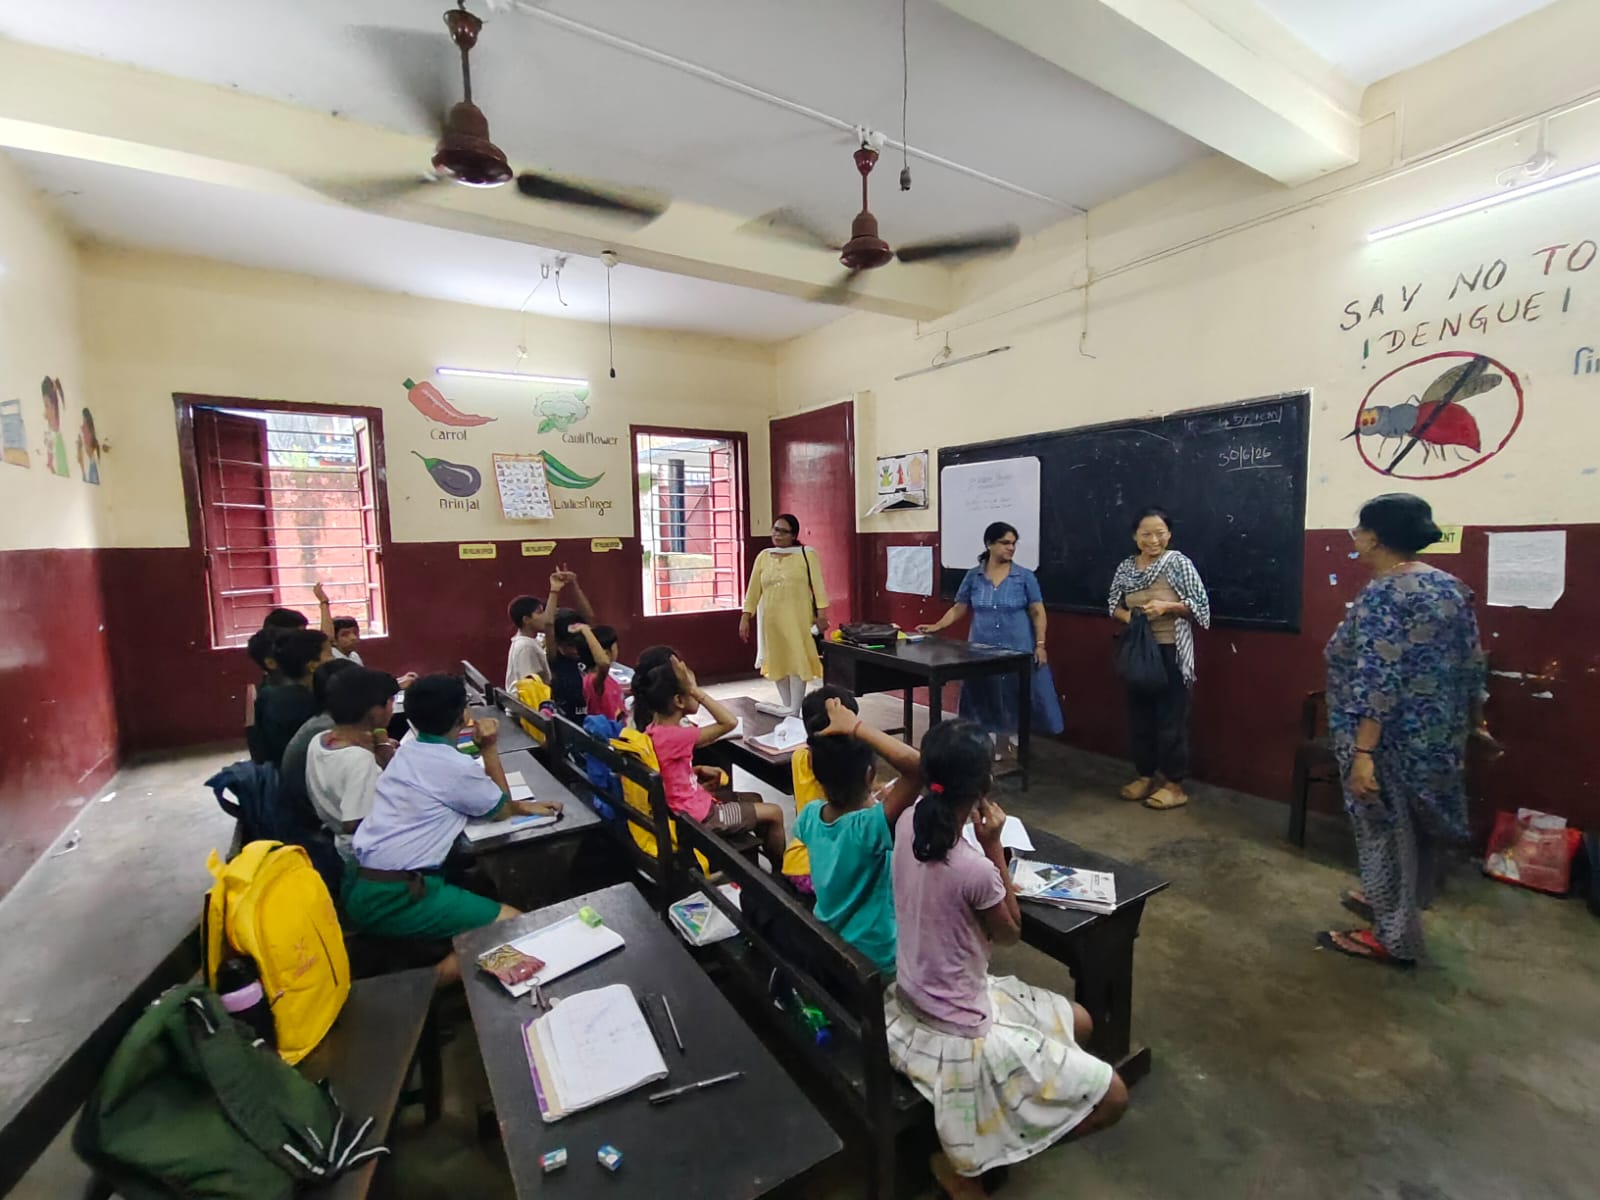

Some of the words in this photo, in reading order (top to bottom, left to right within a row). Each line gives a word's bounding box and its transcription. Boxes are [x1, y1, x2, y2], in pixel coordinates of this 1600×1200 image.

[1340, 283, 1423, 331] SAY
[1449, 259, 1508, 300] NO
[1532, 240, 1598, 275] TO
